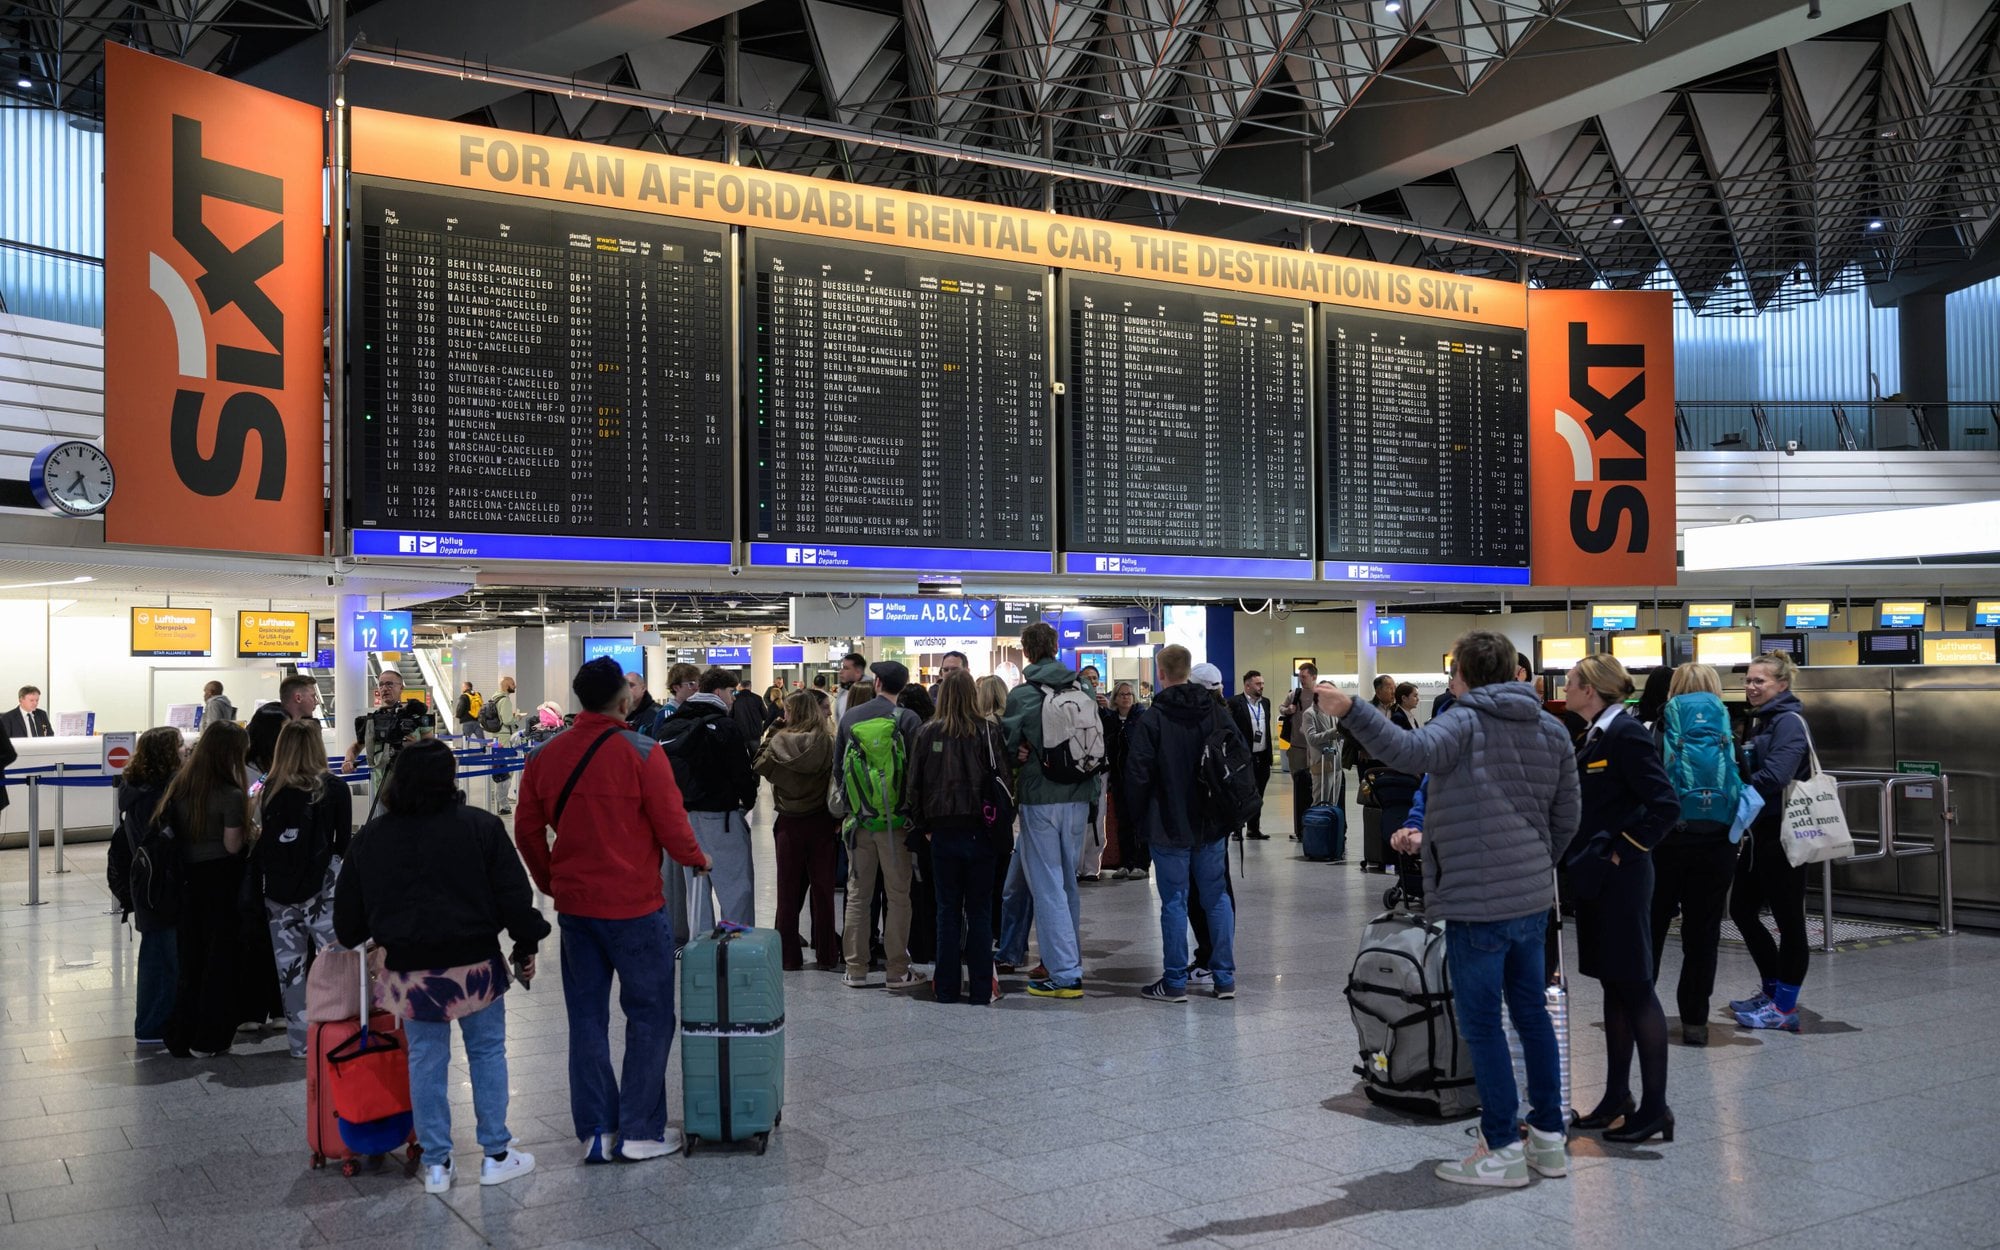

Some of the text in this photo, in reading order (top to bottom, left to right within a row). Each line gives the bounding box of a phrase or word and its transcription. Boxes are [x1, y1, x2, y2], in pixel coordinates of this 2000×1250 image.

[459, 135, 1480, 314] FOR AN AFFORDABLE RENTAL CAR, THE DESTINATION IS SIXT.
[417, 255, 541, 277] 172 BERLIN-CANCELLED
[411, 266, 552, 290] 1004 BRUESSEL-CANCELLED
[411, 278, 535, 299] 1200 BASEL-CANCELLED
[822, 280, 911, 298] DUESSELDR-CANCELLED
[149, 113, 287, 502] SIXT
[417, 290, 547, 311] 246 MAILAND-CANCELLED
[417, 301, 558, 323] 390 LUXEMBURG-CANCELLED
[823, 311, 898, 327] BERLIN-CANCELLED
[417, 313, 541, 333] 976 DUBLIN-CANCELLED
[417, 324, 541, 344] 050 BREMEN-CANCELLED
[823, 332, 856, 343] ZUERICH
[417, 336, 530, 354] 858 OSLO-CANCELLED
[823, 342, 912, 358] AMSTERDAM-CANCELLED
[412, 347, 477, 361] 1278 ATHEN
[418, 359, 553, 378] 040 HANNOVER-CANCELLED
[823, 362, 907, 377] BERLIN-BRANDENBURG
[418, 370, 559, 390] 130 STUTTGART-CANCELLED
[823, 373, 856, 383] HAMBURG
[418, 382, 559, 401] 140 NUERNBERG-CANCELLED
[823, 383, 880, 395] GRAN CANARIA
[412, 393, 564, 412] 3600 DORTMUND-KOELN HBF-D
[412, 404, 564, 423] 3640 HAMBURG-MUENSTER-OSN
[418, 416, 495, 430] 094 MUENCHEN
[824, 424, 843, 433] PISA
[418, 428, 524, 443] 230 ROM-CANCELLED
[824, 434, 903, 447] HAMBURG-CANCELLED
[1554, 321, 1649, 553] SIXT
[412, 439, 553, 456] 1346 WARSCHAU-CANCELLED
[824, 444, 899, 456] LONDON-CANCELLED
[418, 451, 559, 467] 800 STOCKHOLM-CANCELLED
[824, 454, 894, 466] NIZZA-CANCELLED
[412, 462, 530, 477] 1392 PRAG-CANCELLED
[824, 464, 857, 474] ANTALYA
[824, 474, 904, 486] BOLOGNA-CANCELLED
[412, 486, 536, 500] 1026 PARIS-CANCELLED
[824, 485, 904, 496] PALERMO-CANCELLED
[412, 497, 559, 512] 1124 BARCELONA-CANCELLED
[825, 505, 844, 513] GENF
[412, 509, 560, 523] 1124 BARCELONA-CANCELLED
[440, 537, 463, 546] Abflug
[440, 546, 478, 555] Departures
[818, 549, 837, 557] Abflug
[818, 557, 849, 566] Departures
[1121, 565, 1147, 573] Departures
[886, 603, 906, 612] Abflug
[154, 615, 196, 624] Lufthansa
[258, 617, 296, 627] Lufthansa
[886, 612, 918, 621] Departures
[362, 628, 377, 648] 12
[390, 628, 409, 648] 12
[914, 638, 946, 647] worldshop
[1389, 629, 1403, 644] 11
[1936, 642, 1982, 650] Lufthansa
[1936, 653, 1977, 661] Business
[1785, 796, 1813, 809] Keep
[1788, 807, 1810, 819] and
[1791, 815, 1840, 829] add more
[1794, 828, 1826, 839] hops.
